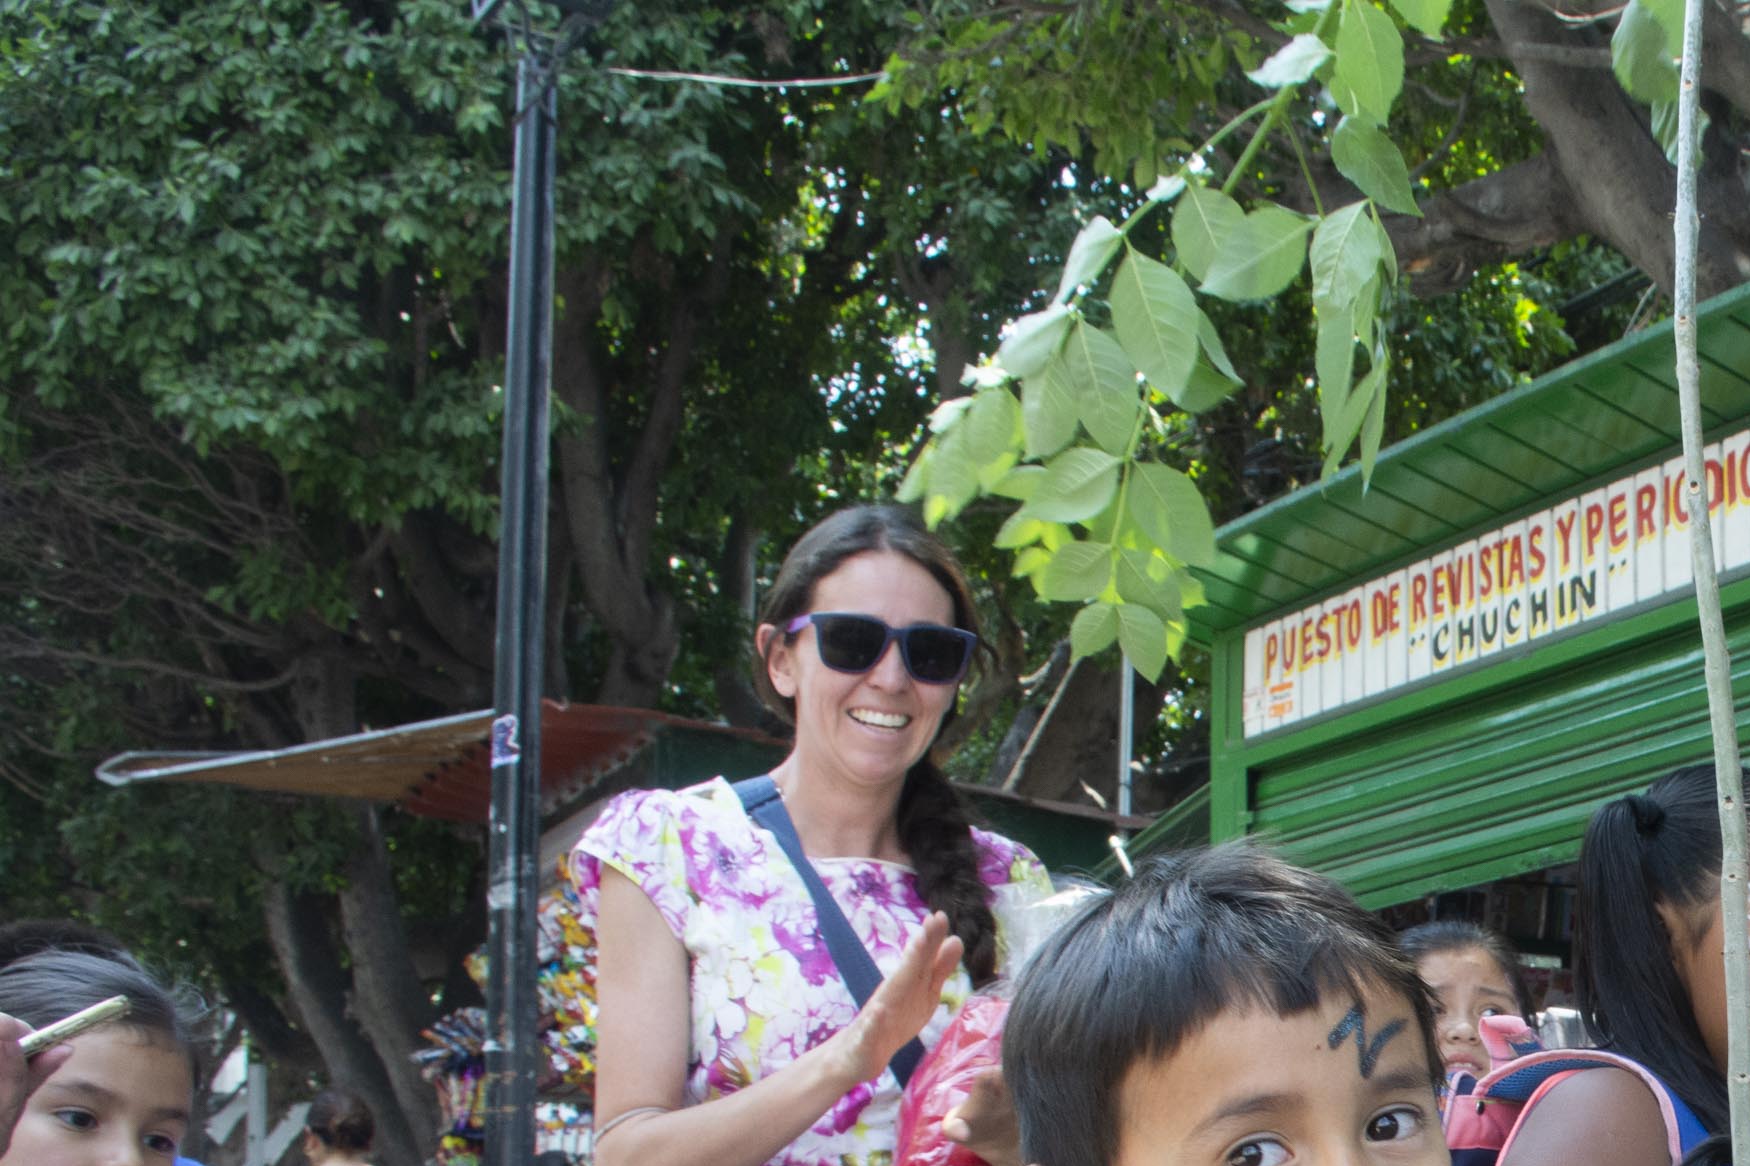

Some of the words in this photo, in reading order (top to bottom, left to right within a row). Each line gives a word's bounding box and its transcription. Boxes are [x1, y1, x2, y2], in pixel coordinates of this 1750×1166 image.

[1264, 597, 1361, 683] PUESTO
[1371, 583, 1401, 646] DE
[1410, 526, 1545, 624] REVISTAS
[1554, 509, 1577, 568] Y
